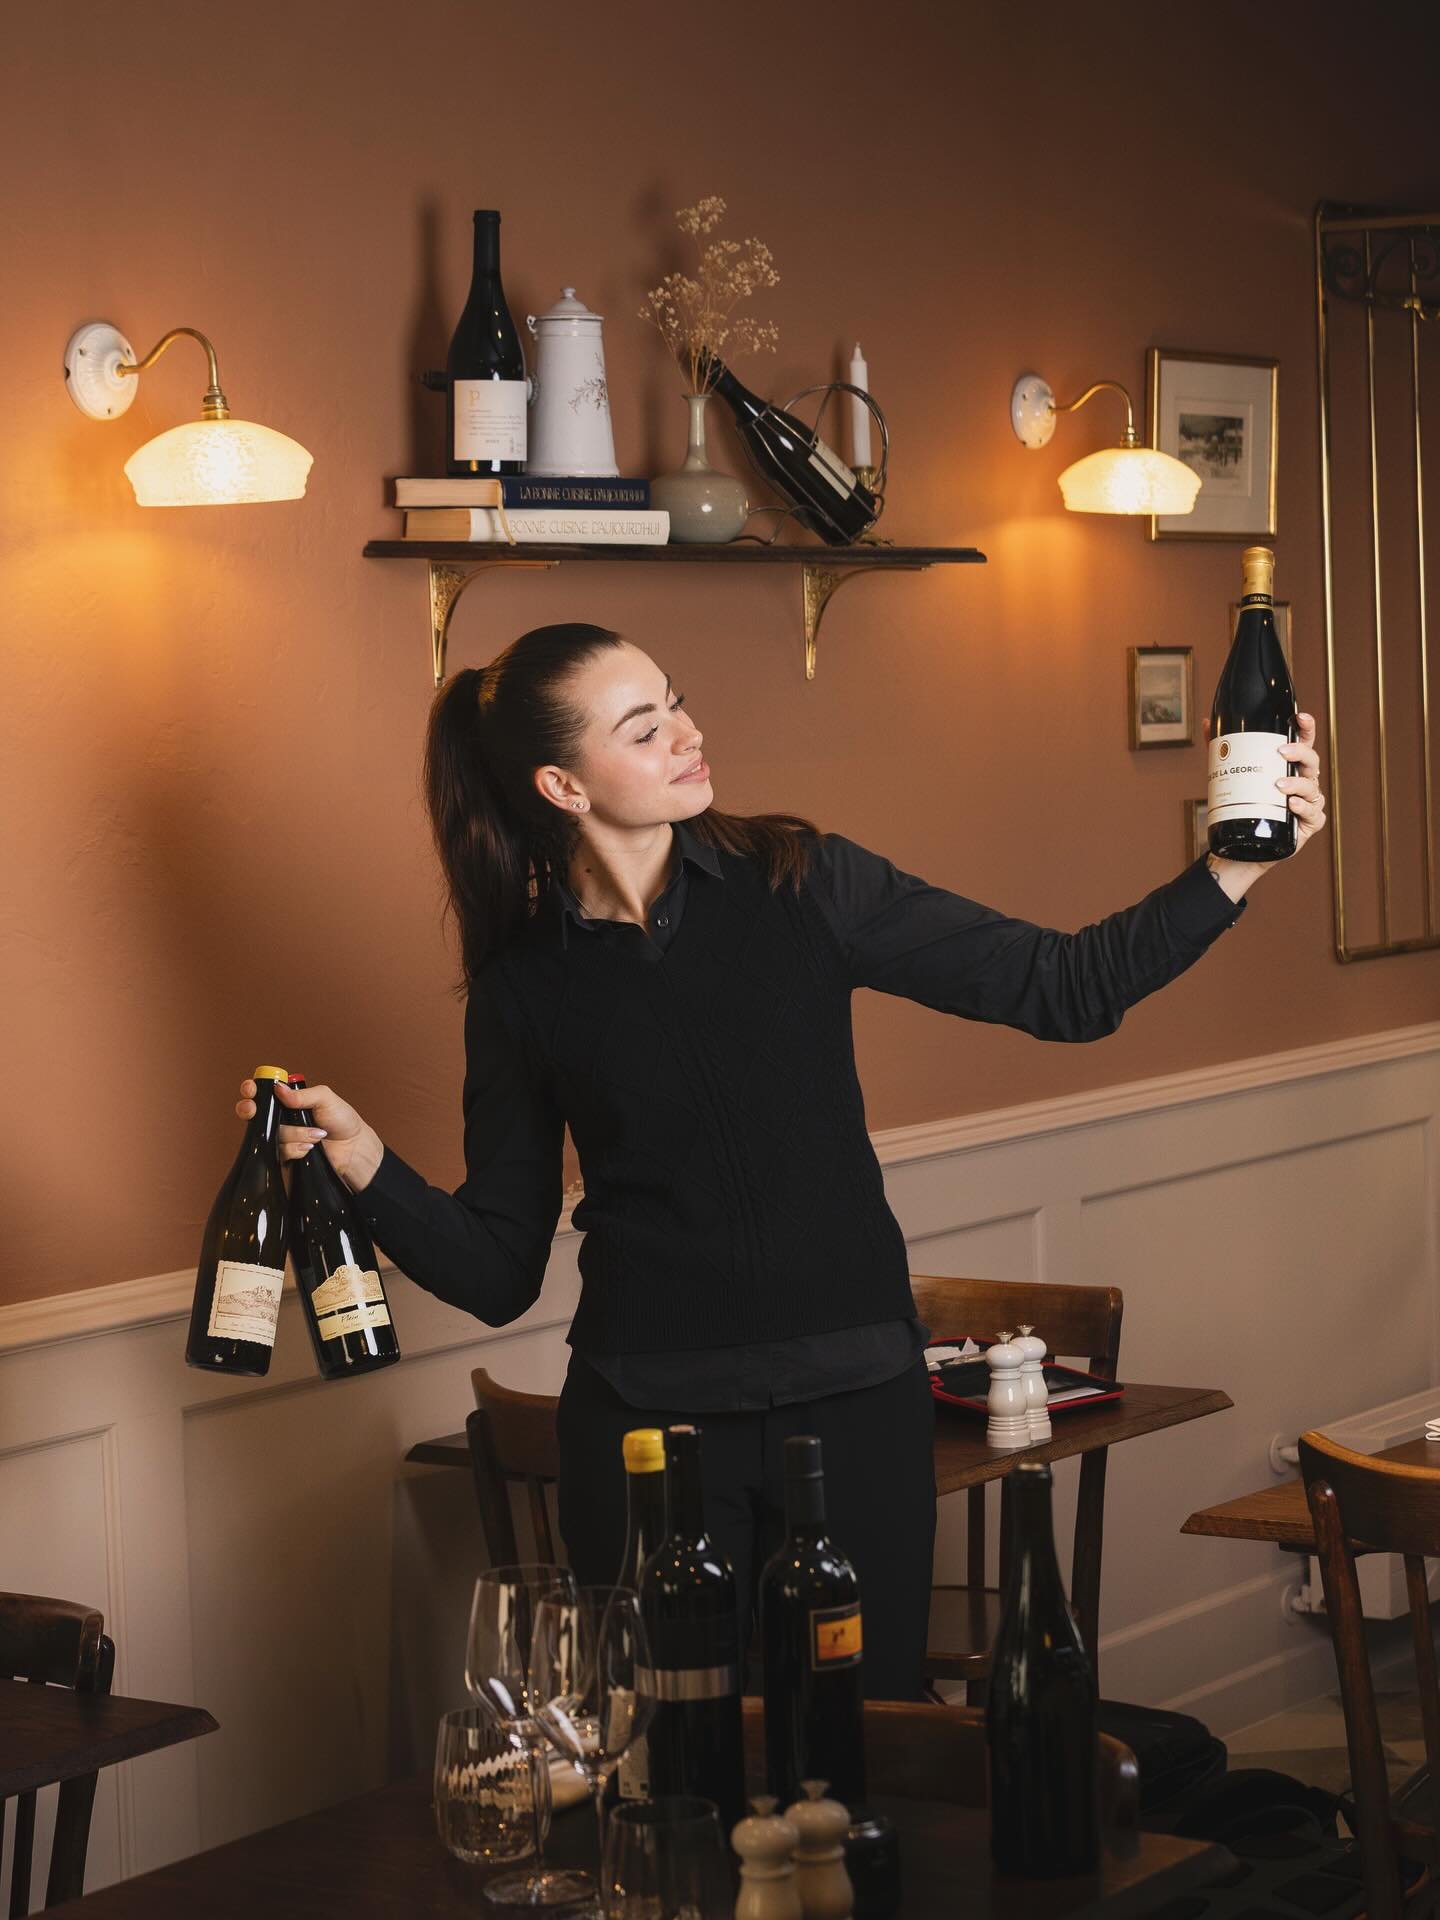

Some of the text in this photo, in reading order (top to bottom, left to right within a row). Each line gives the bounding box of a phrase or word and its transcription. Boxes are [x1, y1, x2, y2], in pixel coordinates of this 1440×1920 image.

[519, 486, 532, 500] LA
[532, 487, 560, 501] BONNE
[561, 488, 593, 502] CUISINE
[509, 519, 546, 534] BONNE
[548, 520, 589, 535] CUISINE
[1219, 769, 1228, 777] LA
